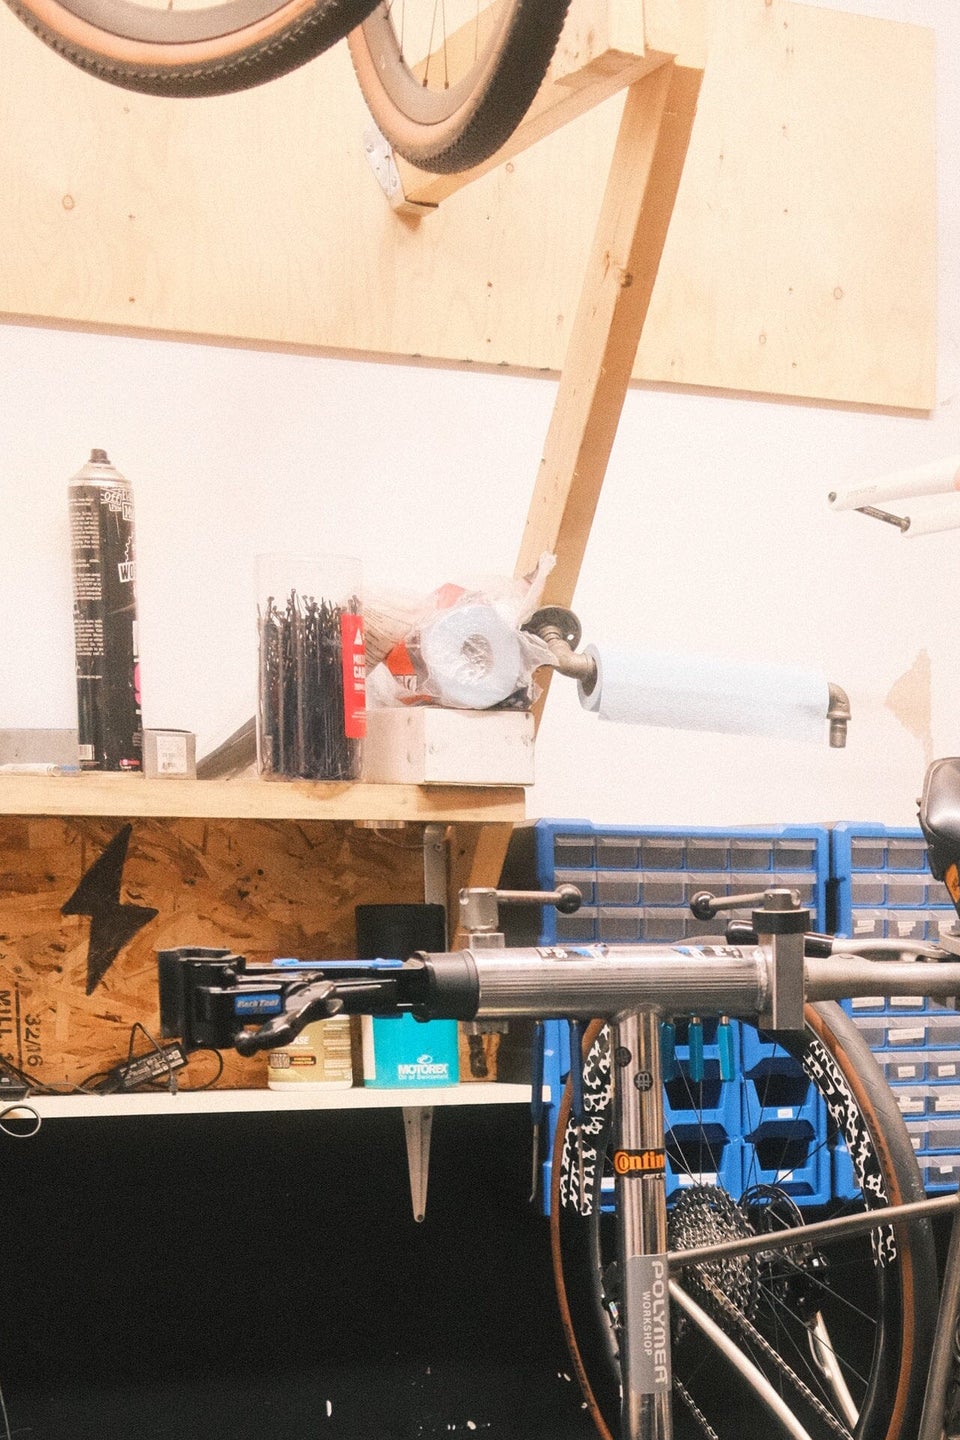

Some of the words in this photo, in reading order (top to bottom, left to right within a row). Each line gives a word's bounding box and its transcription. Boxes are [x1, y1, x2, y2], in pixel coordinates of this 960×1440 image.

[397, 1064, 449, 1075] MOTOREX
[642, 1290, 653, 1356] WORKSHOP
[651, 1260, 669, 1385] POLYMER
